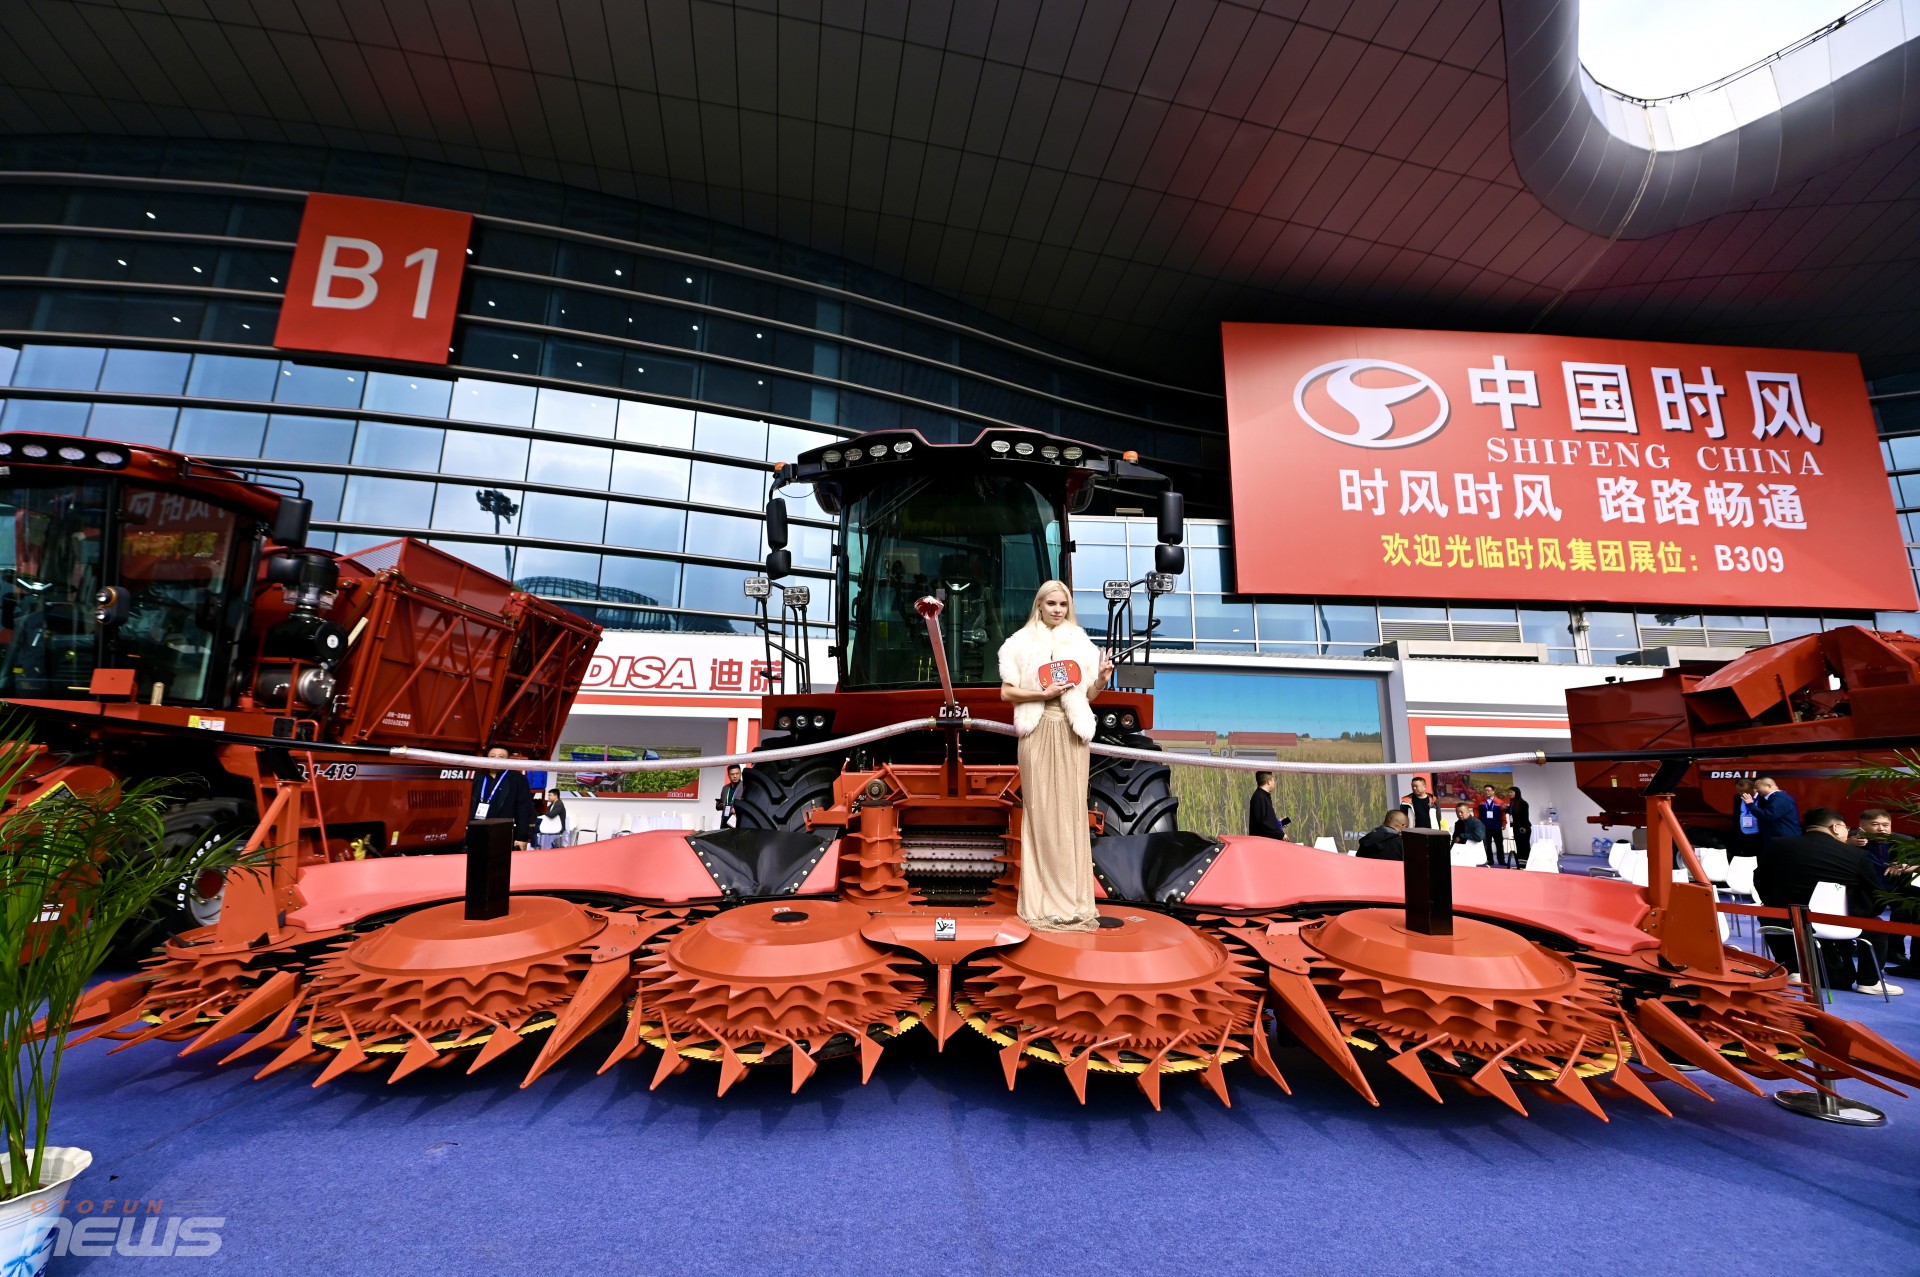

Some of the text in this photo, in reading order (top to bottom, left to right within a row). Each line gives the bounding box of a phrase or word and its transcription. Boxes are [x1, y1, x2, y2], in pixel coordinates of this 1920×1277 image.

[312, 235, 439, 319] B1
[1467, 354, 1822, 443] 中国时风
[1486, 436, 1824, 476] SHIFENG CHINA
[1339, 467, 1808, 531] 时风时风 路路畅通
[1714, 544, 1785, 574] B309
[581, 655, 697, 690] DISA
[440, 769, 464, 780] DISA
[1711, 771, 1742, 779] DISA
[1344, 830, 1368, 840] DIS
